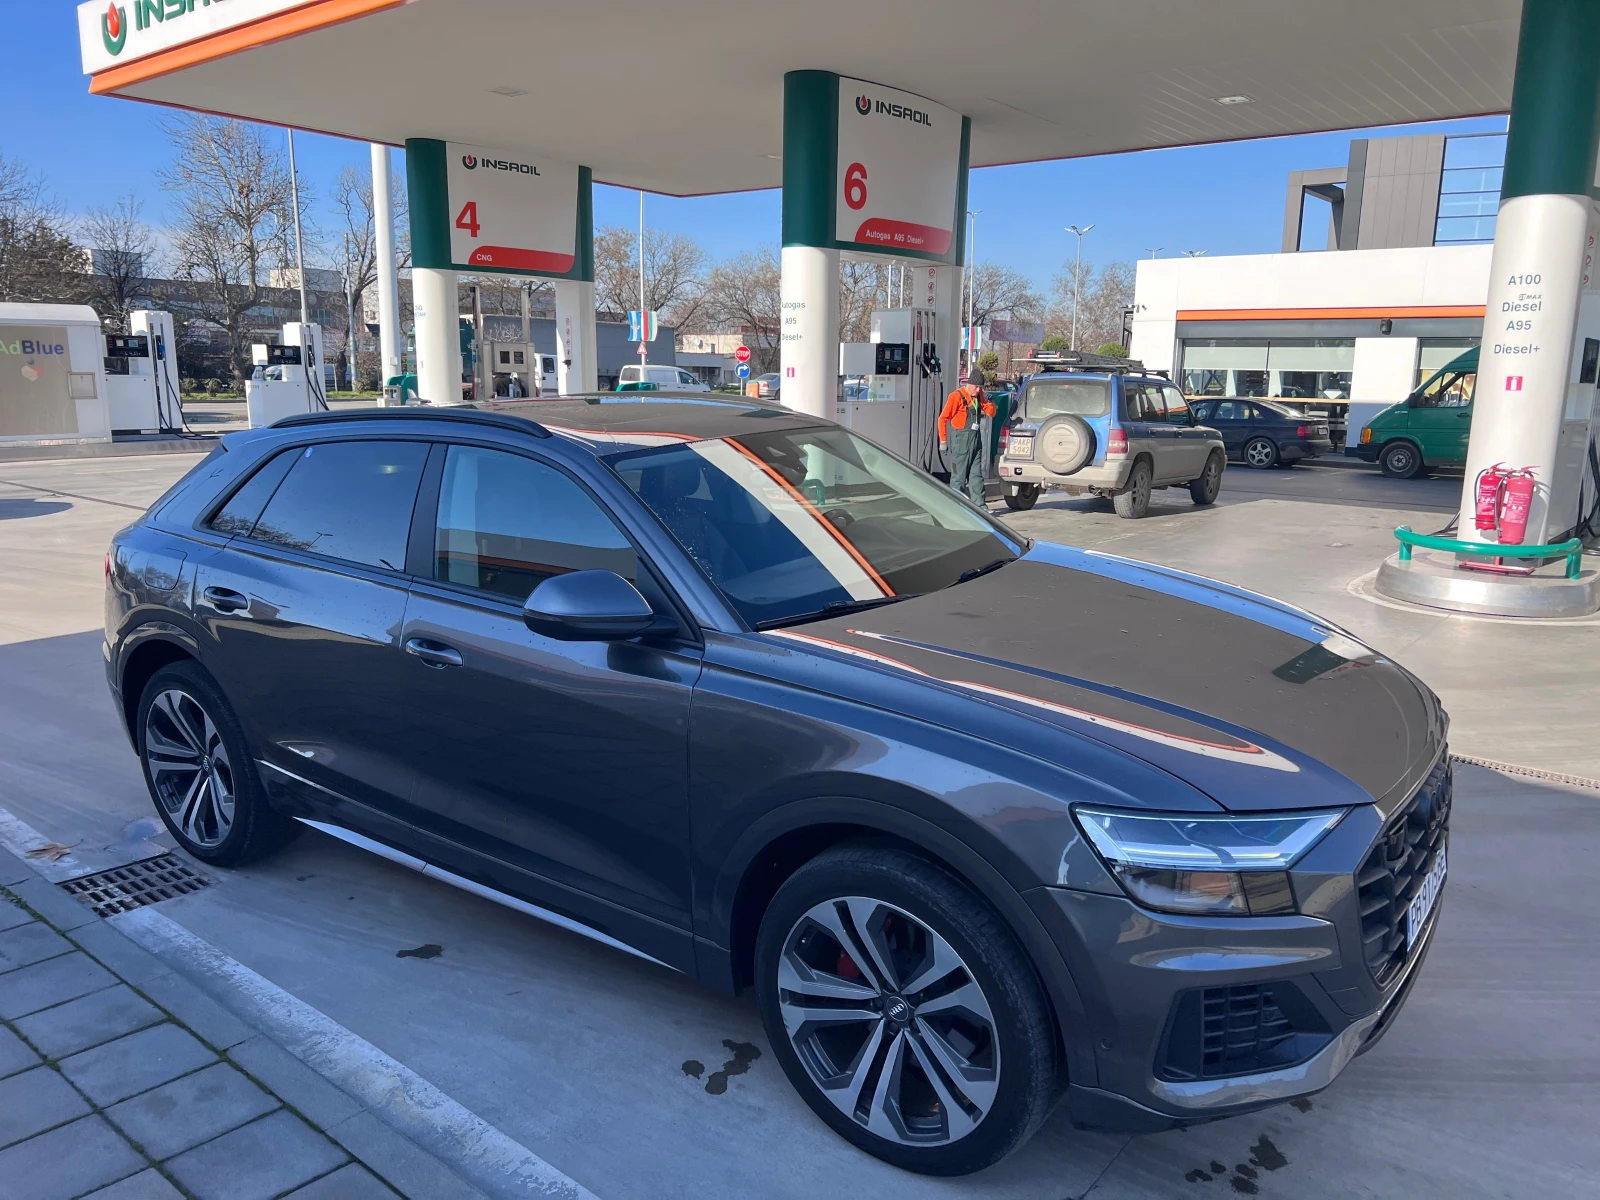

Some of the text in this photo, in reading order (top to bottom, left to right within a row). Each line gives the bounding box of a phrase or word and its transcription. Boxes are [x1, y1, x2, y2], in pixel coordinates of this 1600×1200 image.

[875, 100, 932, 127] INSAOIL
[481, 158, 541, 176] INSAOIL
[844, 162, 868, 211] 6
[456, 201, 481, 238] 4
[865, 229, 891, 241] Autogas
[893, 232, 905, 242] A95
[476, 253, 493, 262] CNG
[1508, 274, 1542, 286] A100
[1502, 301, 1542, 312] Diesel
[785, 317, 797, 325] A95
[1506, 320, 1532, 331] A95
[0, 340, 64, 355] AdBlue
[1493, 344, 1541, 355] Diesel+
